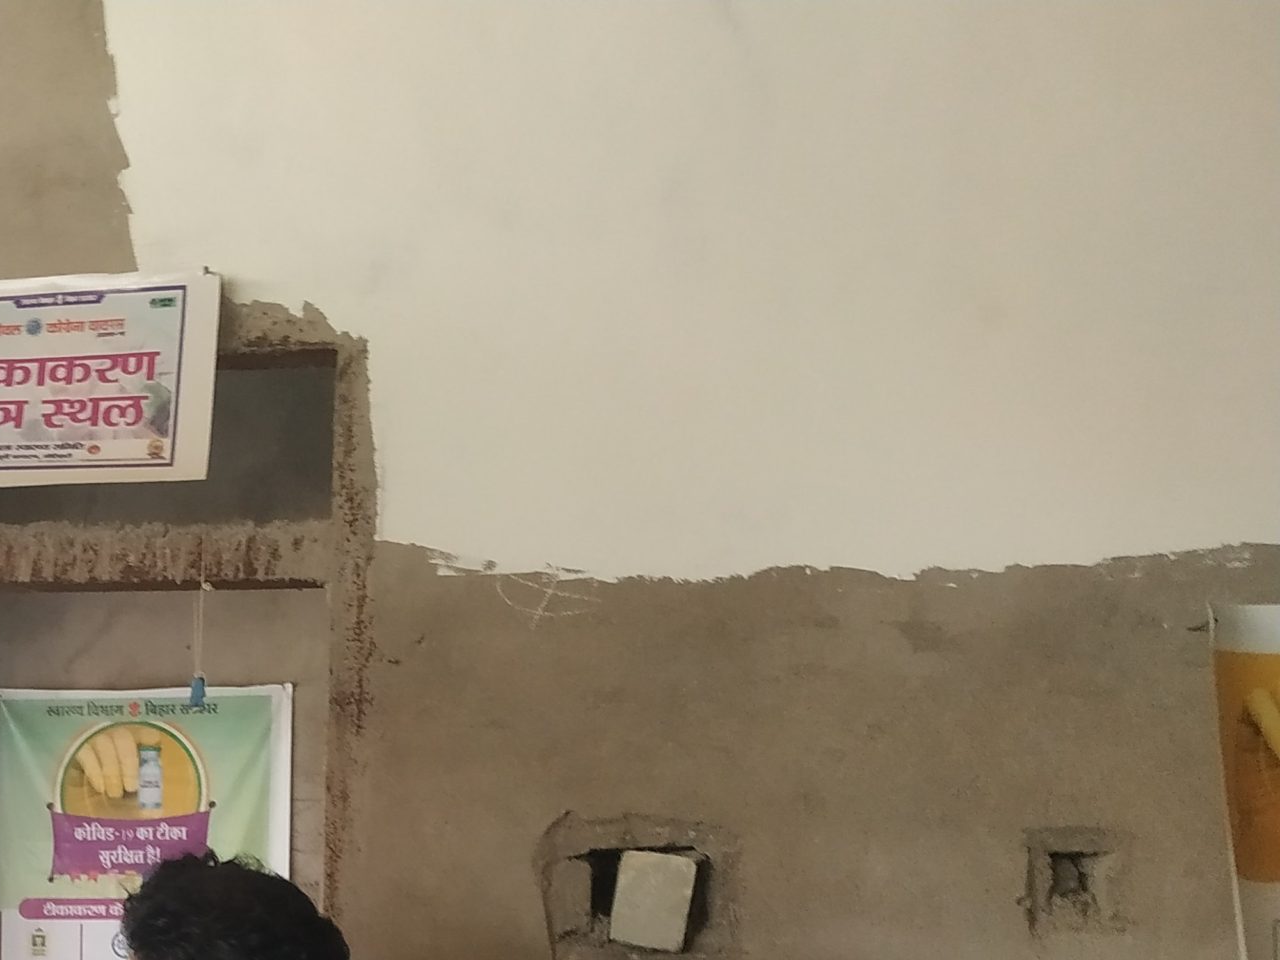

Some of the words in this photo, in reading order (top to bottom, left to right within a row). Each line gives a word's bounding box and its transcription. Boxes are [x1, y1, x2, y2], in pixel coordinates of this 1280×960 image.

[41, 395, 149, 429] स्थल
[145, 700, 177, 718] बिहार
[136, 826, 154, 841] का
[156, 821, 188, 841] टीका
[99, 844, 145, 869] सुरक्षित
[42, 901, 107, 917] टीकाकरण
